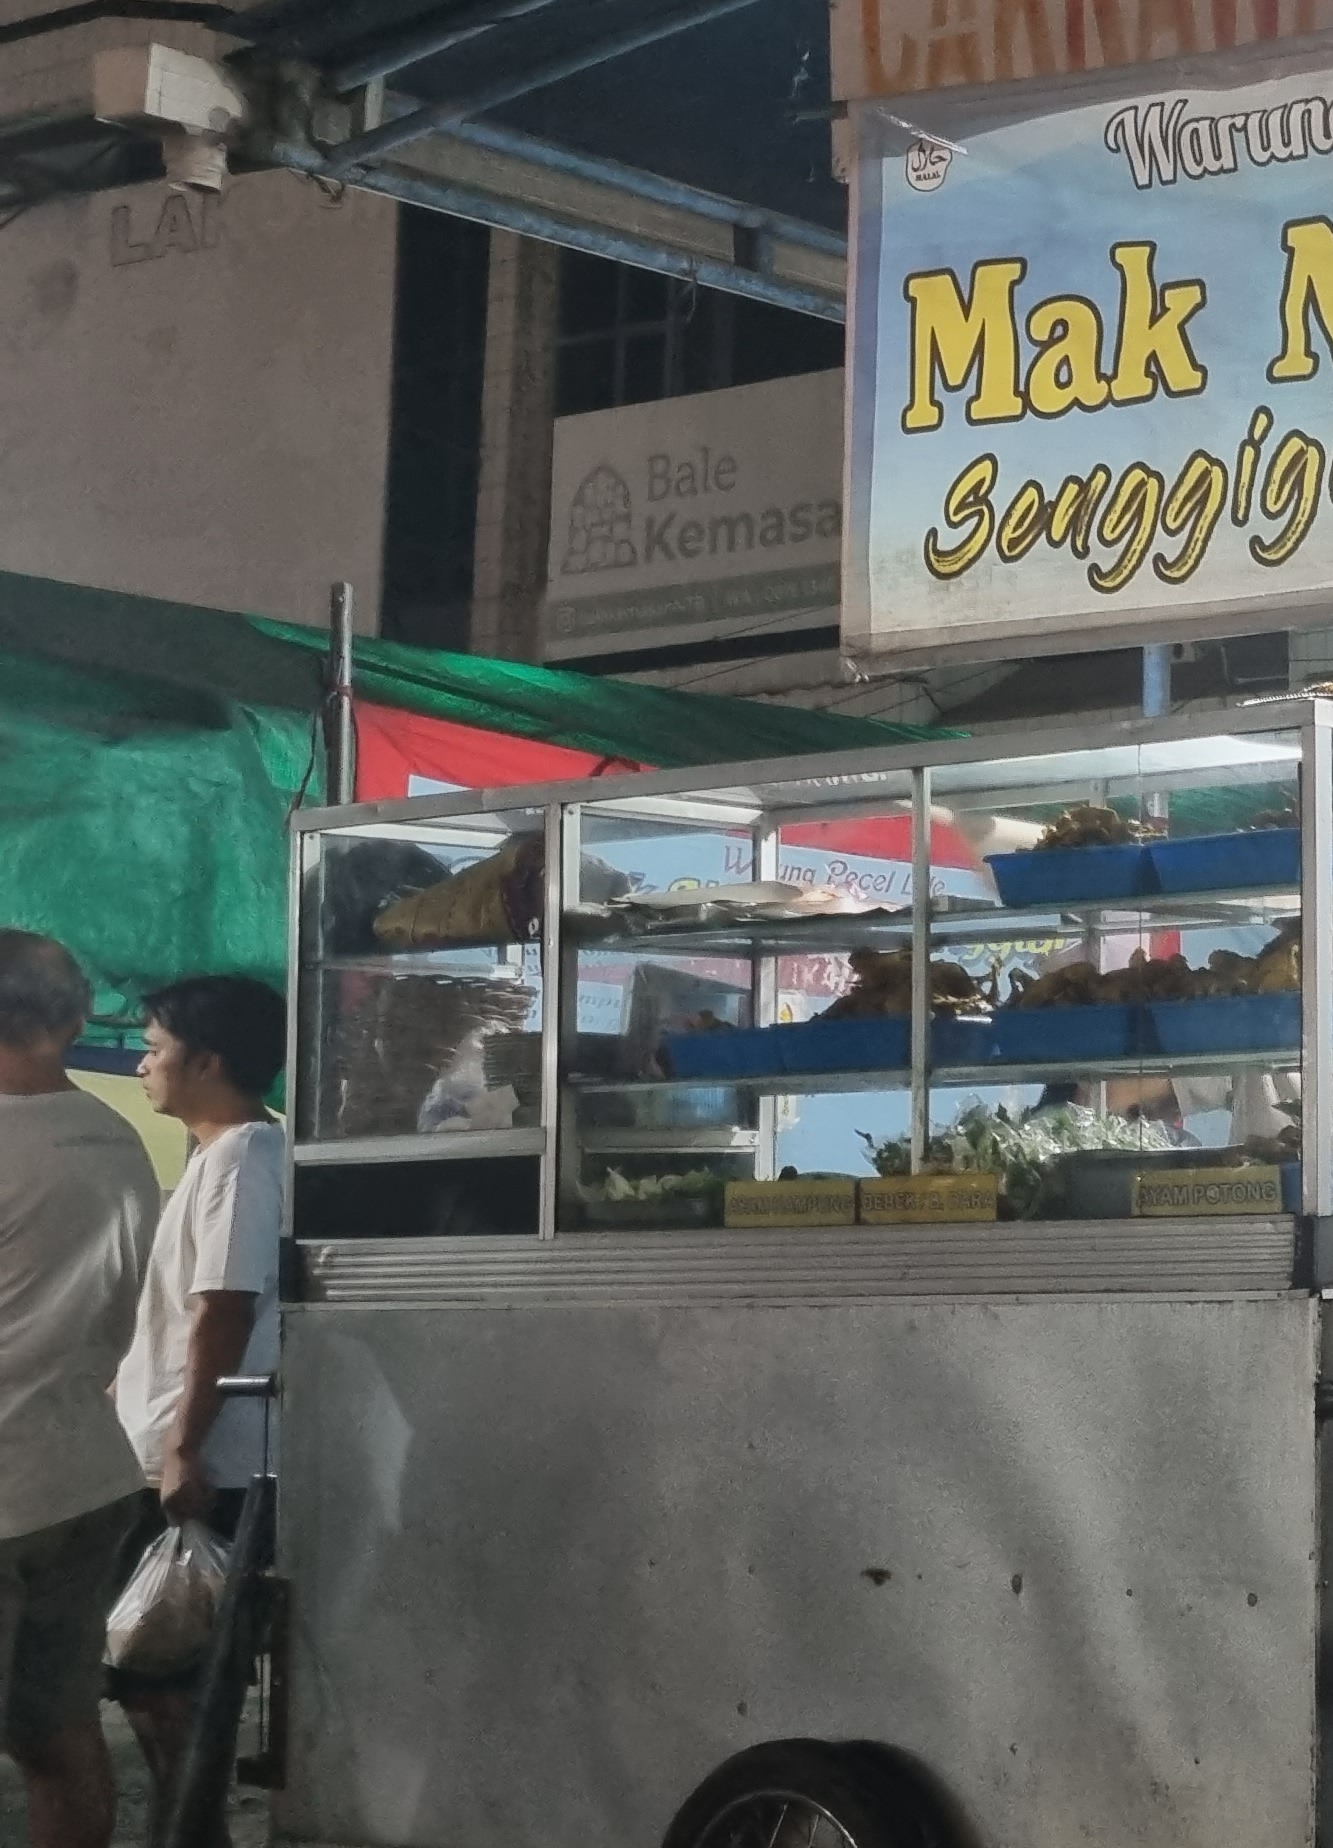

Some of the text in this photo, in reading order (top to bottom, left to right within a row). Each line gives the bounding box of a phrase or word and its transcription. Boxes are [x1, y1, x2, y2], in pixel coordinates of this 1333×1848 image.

[899, 239, 1209, 435] Mak
[646, 446, 738, 502] Bale
[1193, 1180, 1276, 1205] POTONG
